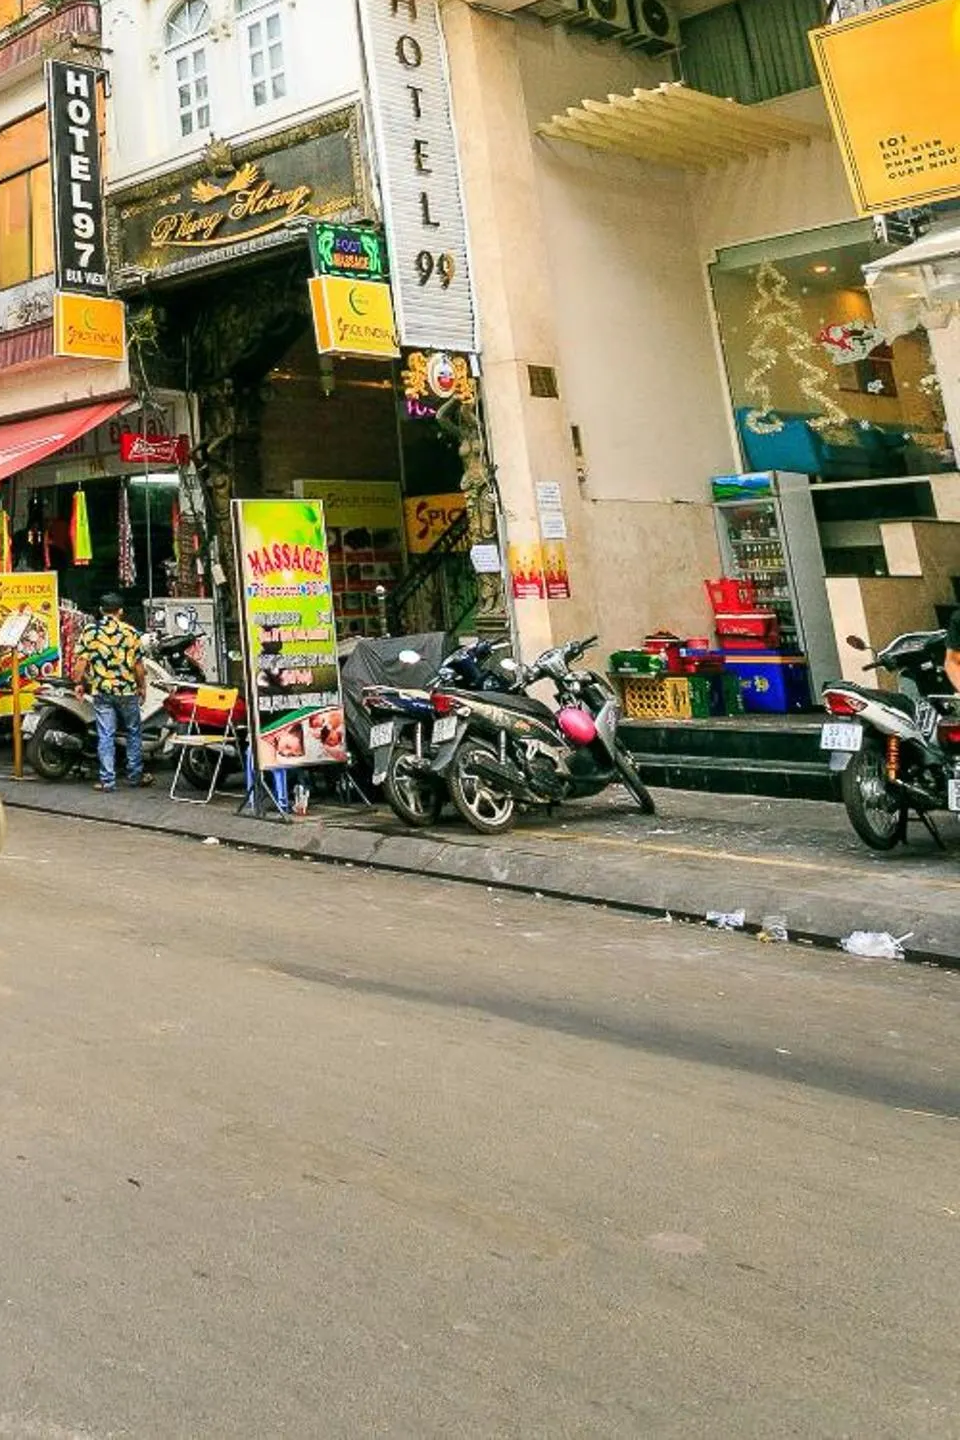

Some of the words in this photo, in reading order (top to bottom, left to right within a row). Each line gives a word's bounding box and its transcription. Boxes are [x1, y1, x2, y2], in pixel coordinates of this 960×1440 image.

[66, 70, 93, 210] HOTEL
[73, 212, 95, 268] 97
[414, 248, 456, 291] 99
[248, 543, 325, 578] MASSAGE
